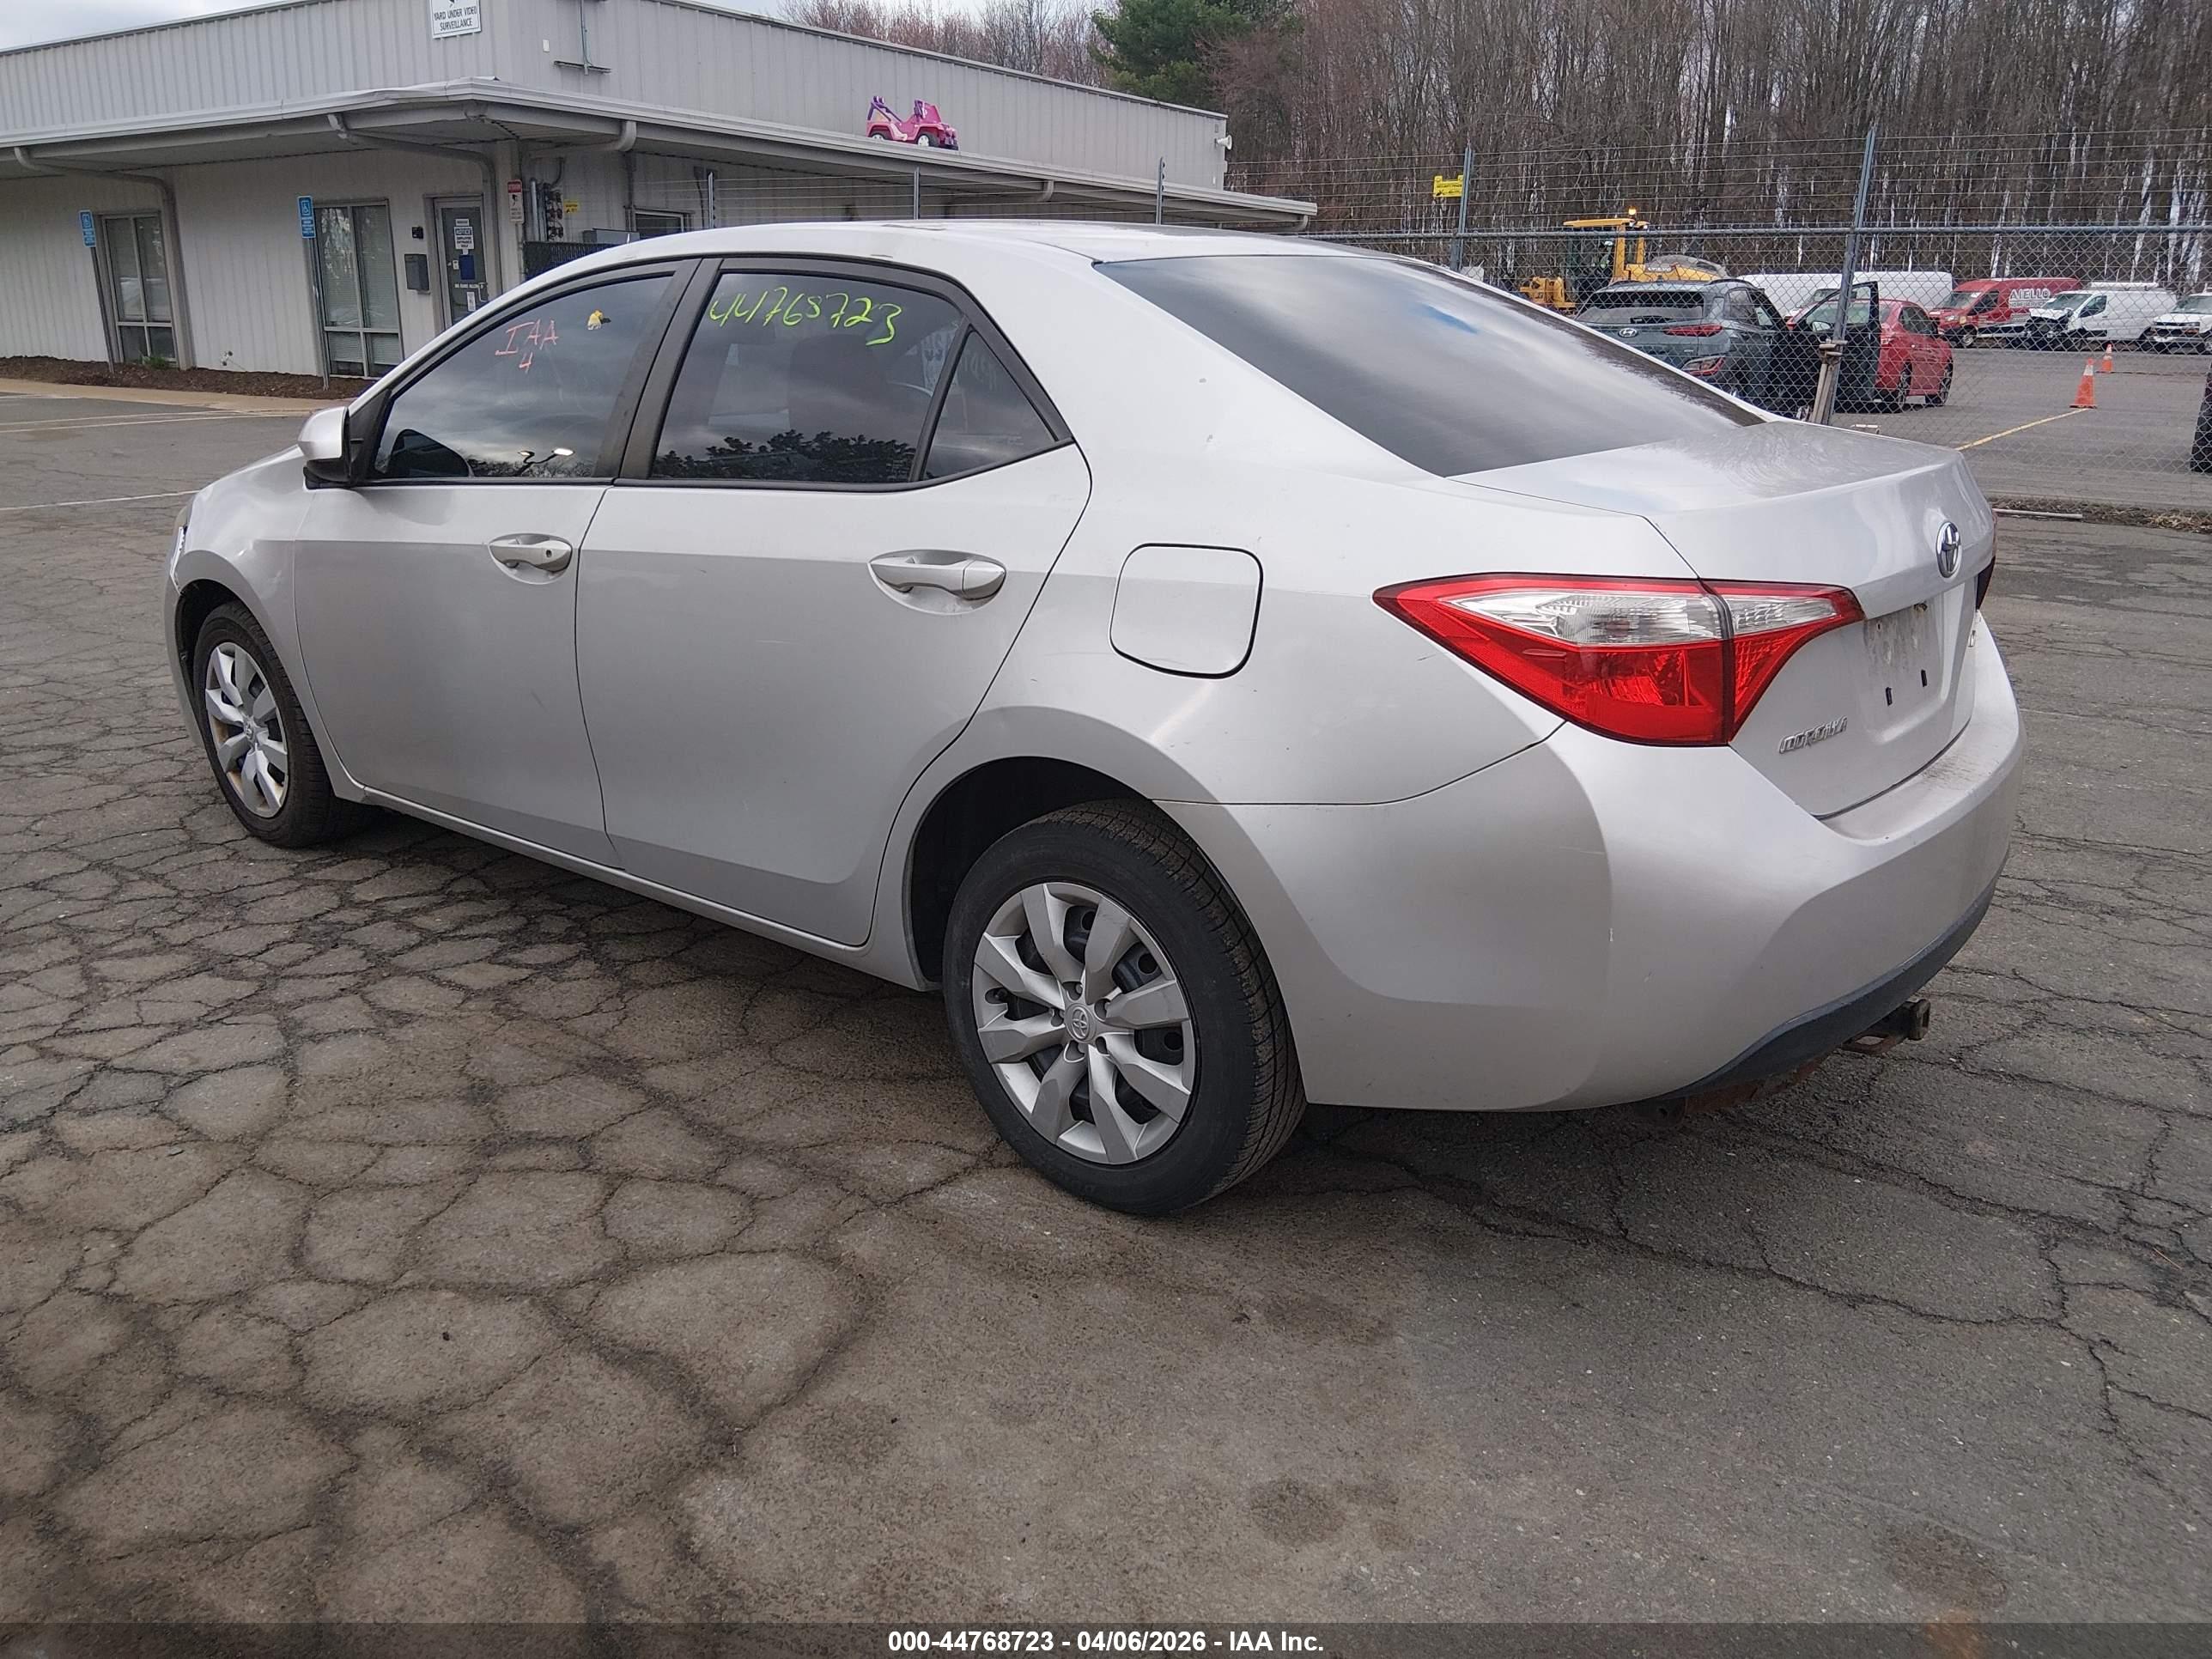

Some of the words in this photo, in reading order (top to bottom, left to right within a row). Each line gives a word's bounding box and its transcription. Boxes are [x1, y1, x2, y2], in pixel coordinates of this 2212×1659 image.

[434, 11, 446, 21] YARD
[447, 9, 462, 19] UNDER
[464, 6, 477, 15] VIDEO
[440, 18, 472, 31] SURVEILLANCE
[2009, 288, 2051, 301] AIELLO
[709, 287, 902, 345] 44768723
[495, 319, 559, 355] IAA
